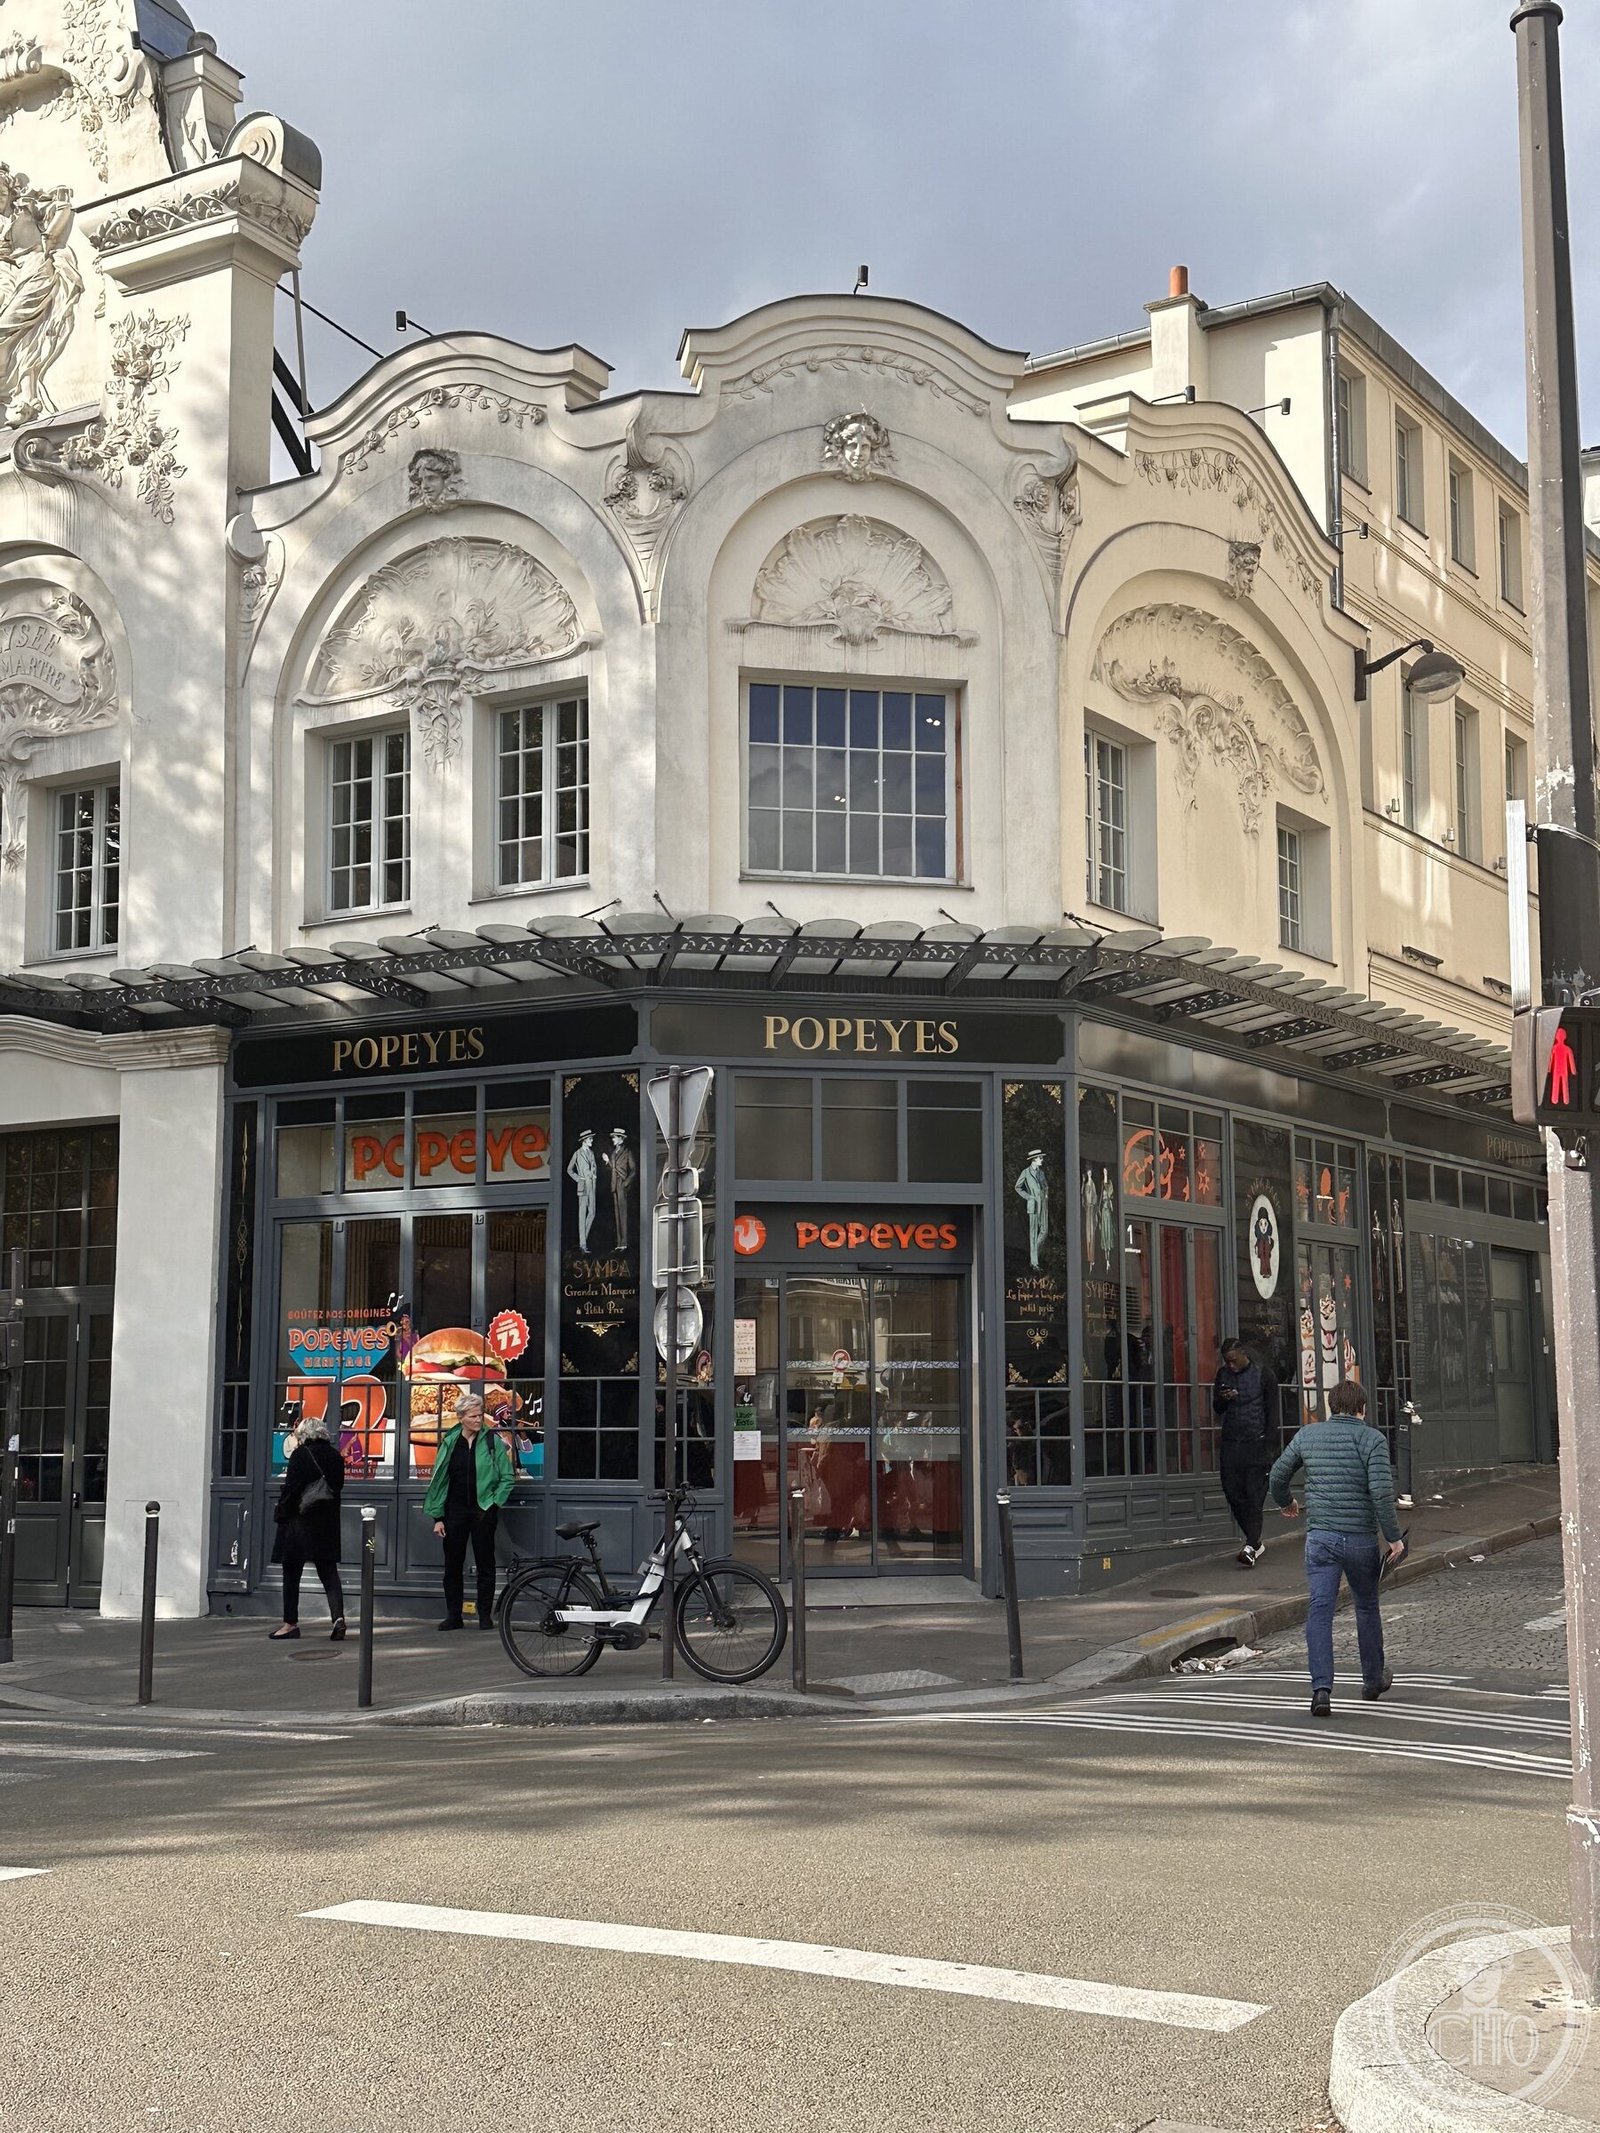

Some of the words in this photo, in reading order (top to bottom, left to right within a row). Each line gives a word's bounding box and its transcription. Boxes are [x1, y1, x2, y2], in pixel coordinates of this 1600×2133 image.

[0, 623, 62, 657] YSEE
[332, 1027, 485, 1072] POPEYES
[763, 1015, 960, 1054] POPEYES
[352, 1124, 550, 1181] POPeYe
[1487, 1134, 1532, 1168] POPEYES
[573, 1259, 631, 1279] SYMPA
[347, 1307, 391, 1319] ORIGINES
[496, 1328, 522, 1351] 72
